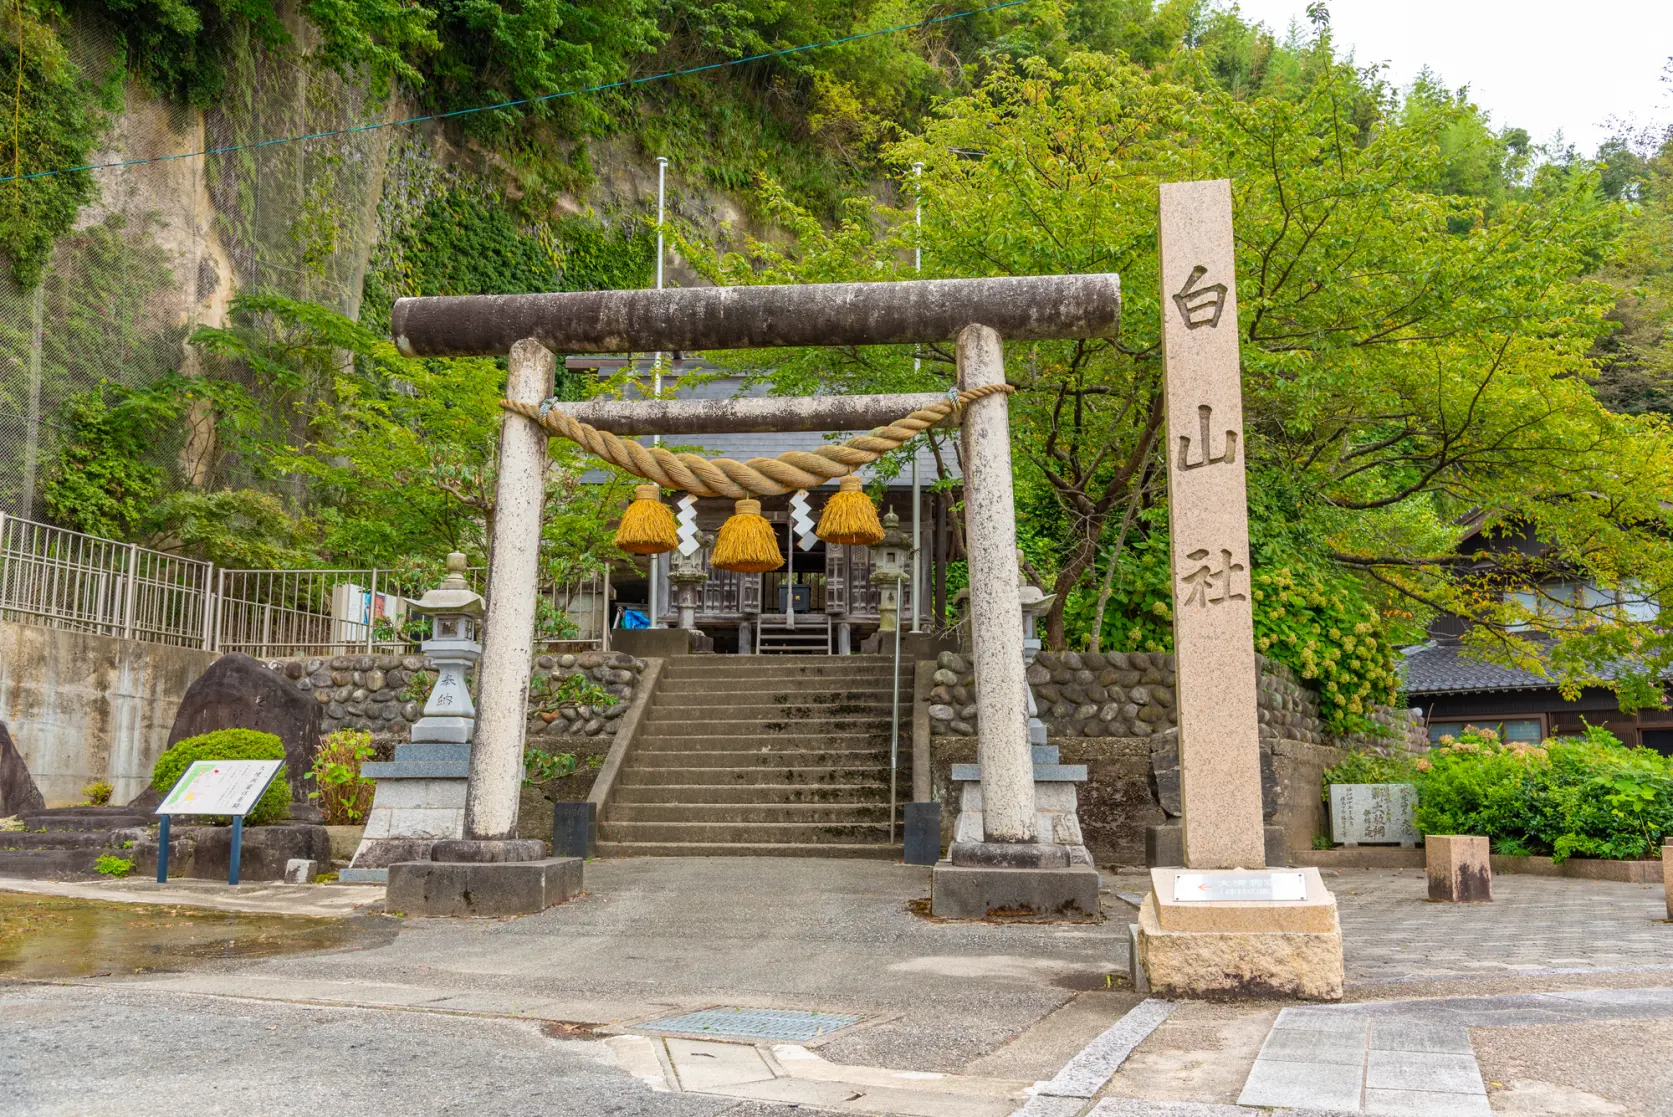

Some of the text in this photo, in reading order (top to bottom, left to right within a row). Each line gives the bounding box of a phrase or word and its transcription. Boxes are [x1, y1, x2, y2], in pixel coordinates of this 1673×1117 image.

[1172, 264, 1246, 607] 白山社
[436, 673, 456, 706] 奉納
